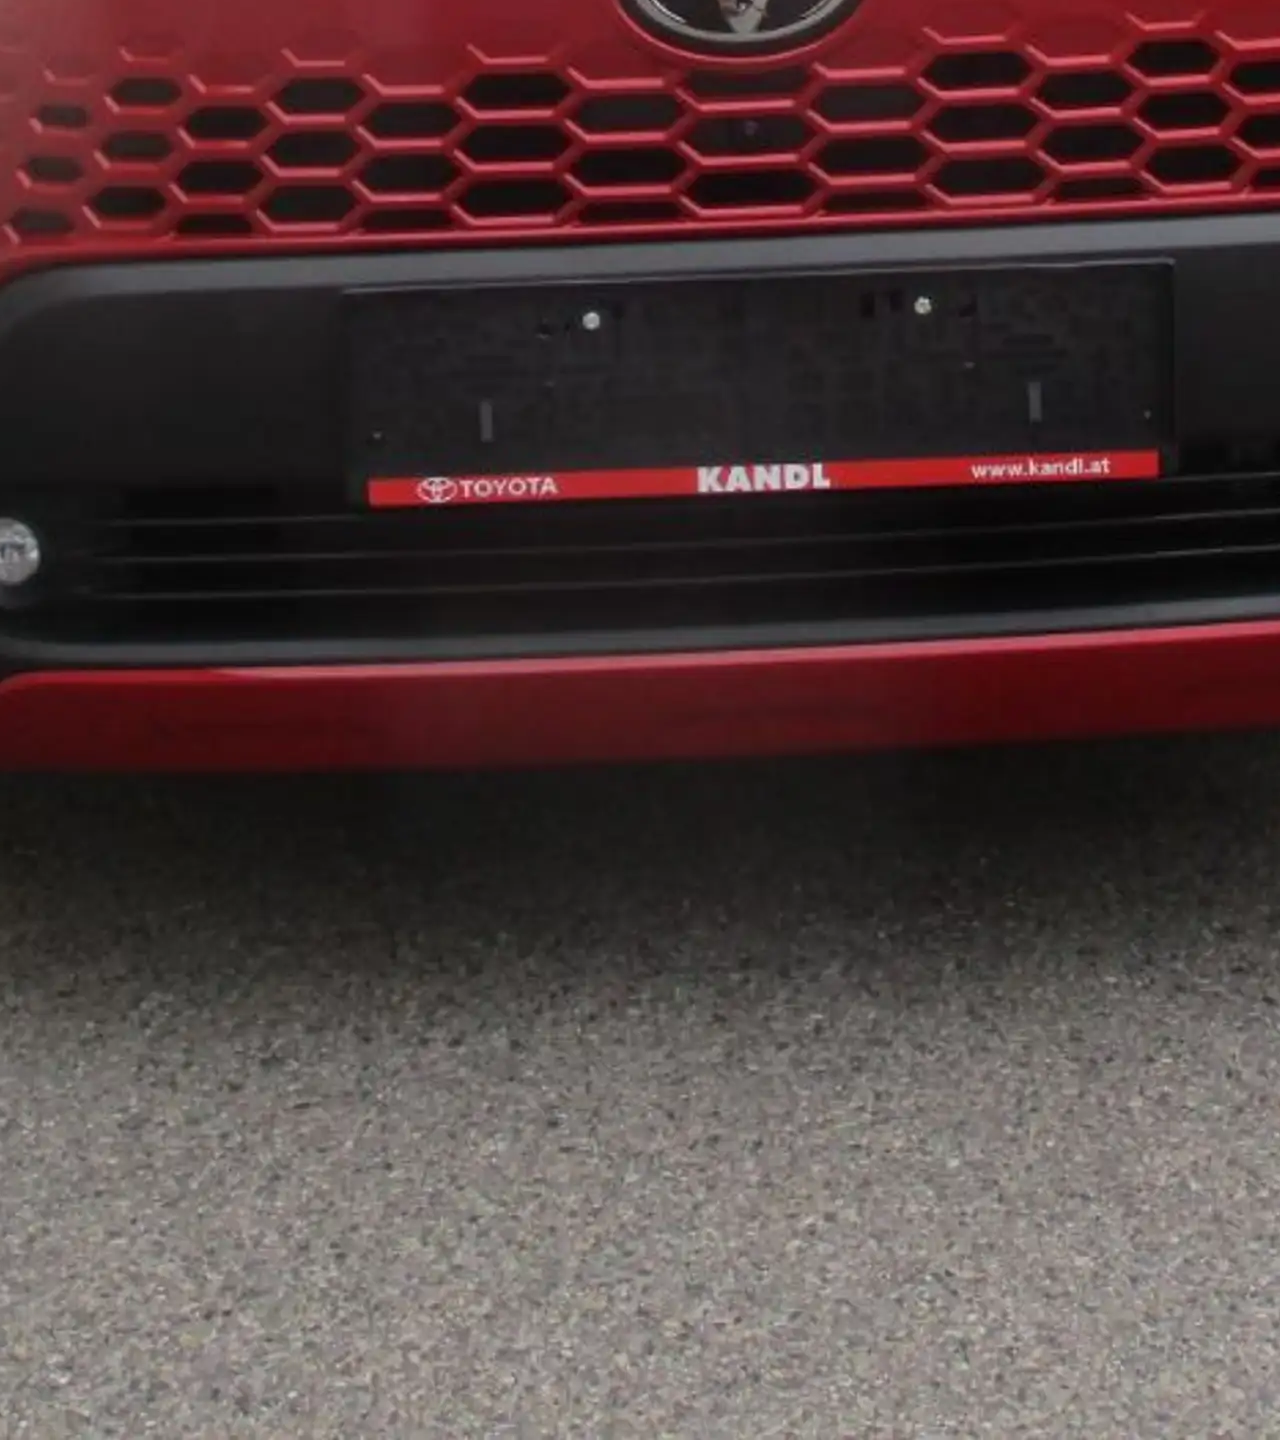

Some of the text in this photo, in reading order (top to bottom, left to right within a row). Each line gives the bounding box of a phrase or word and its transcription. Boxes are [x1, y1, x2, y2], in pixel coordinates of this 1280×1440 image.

[459, 457, 1111, 498] TOYOTA KANDL www.kandl.at
